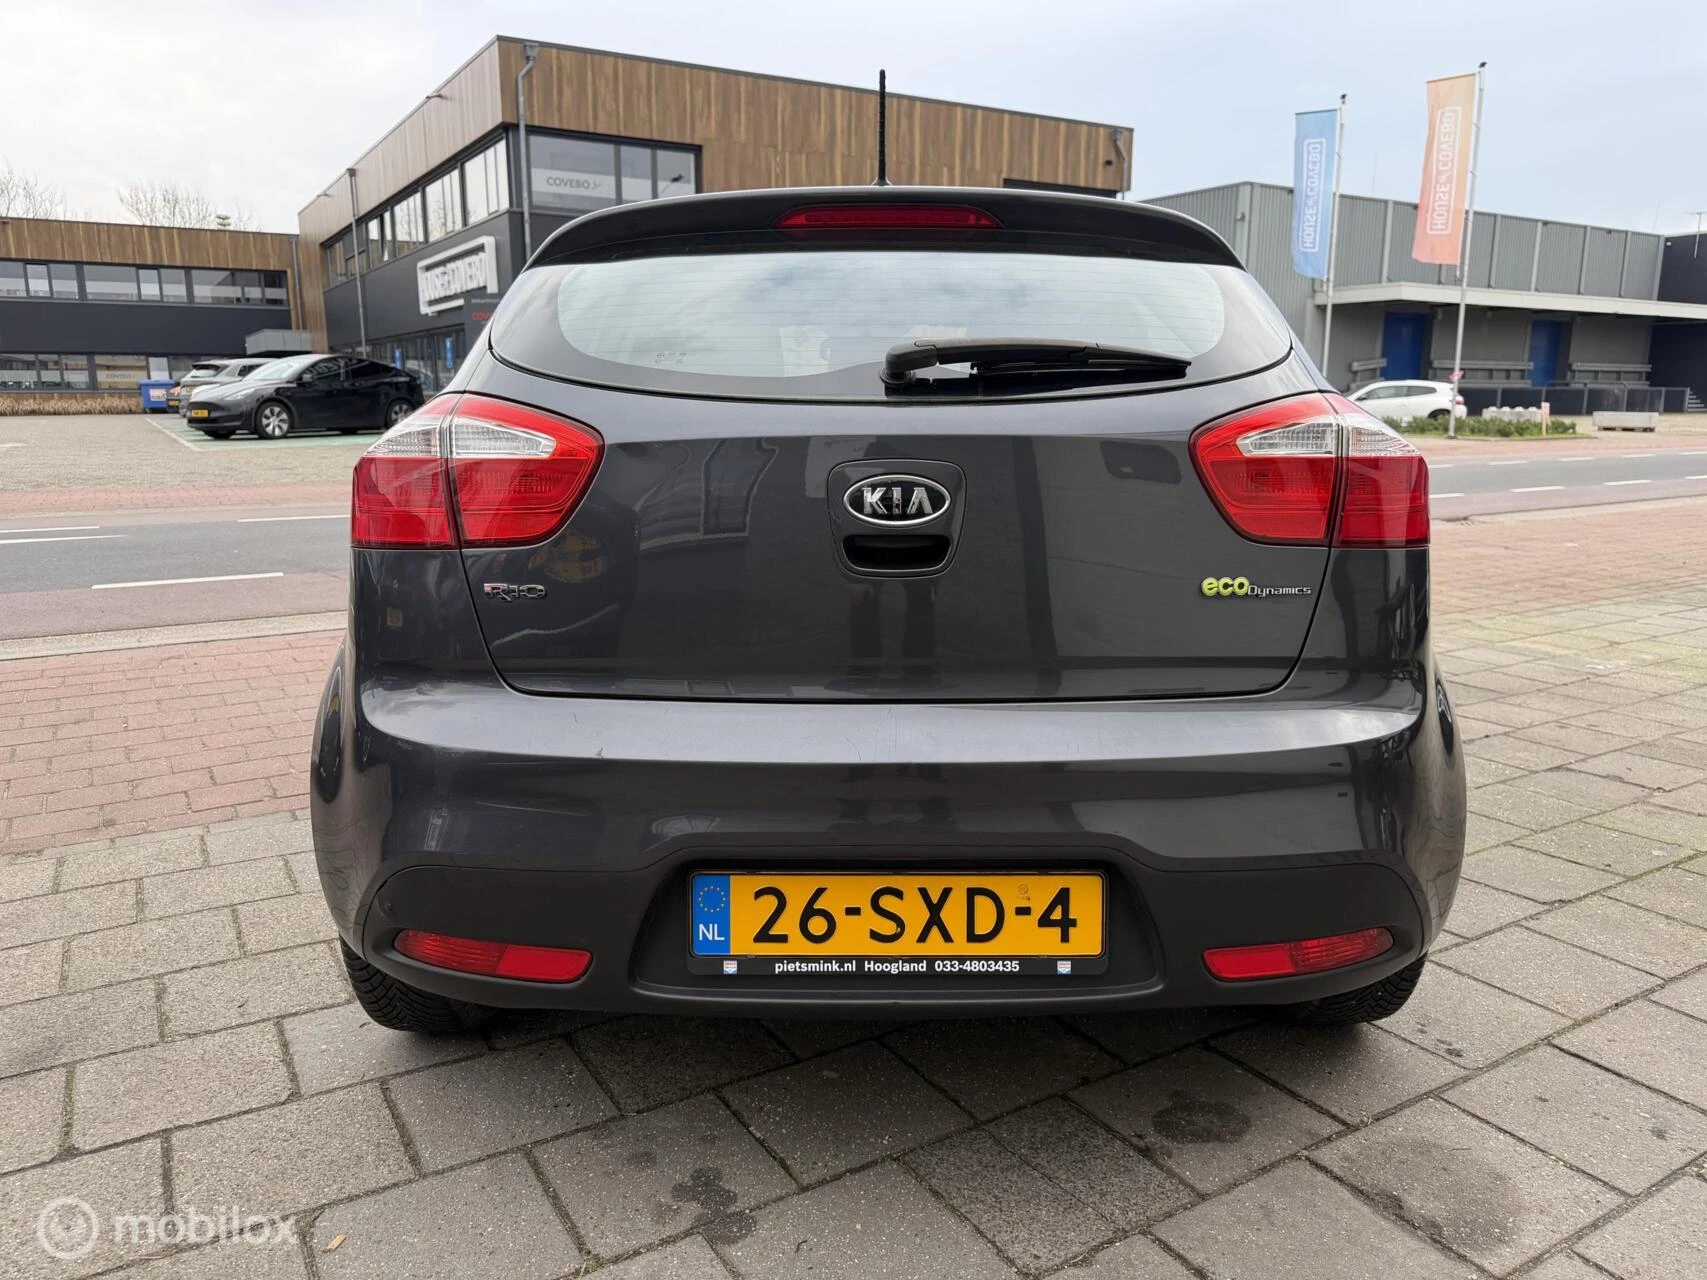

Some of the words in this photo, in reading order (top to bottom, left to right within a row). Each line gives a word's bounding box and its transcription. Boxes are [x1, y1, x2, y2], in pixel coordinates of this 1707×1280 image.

[546, 176, 590, 190] COVEBO
[861, 487, 934, 514] KIA
[483, 583, 546, 601] RIO
[753, 886, 1077, 944] 26-SXD-4
[699, 923, 725, 941] NL
[775, 960, 856, 974] pietsmink.nl
[864, 960, 927, 974] Hoogland
[934, 960, 1020, 972] 033-4803435
